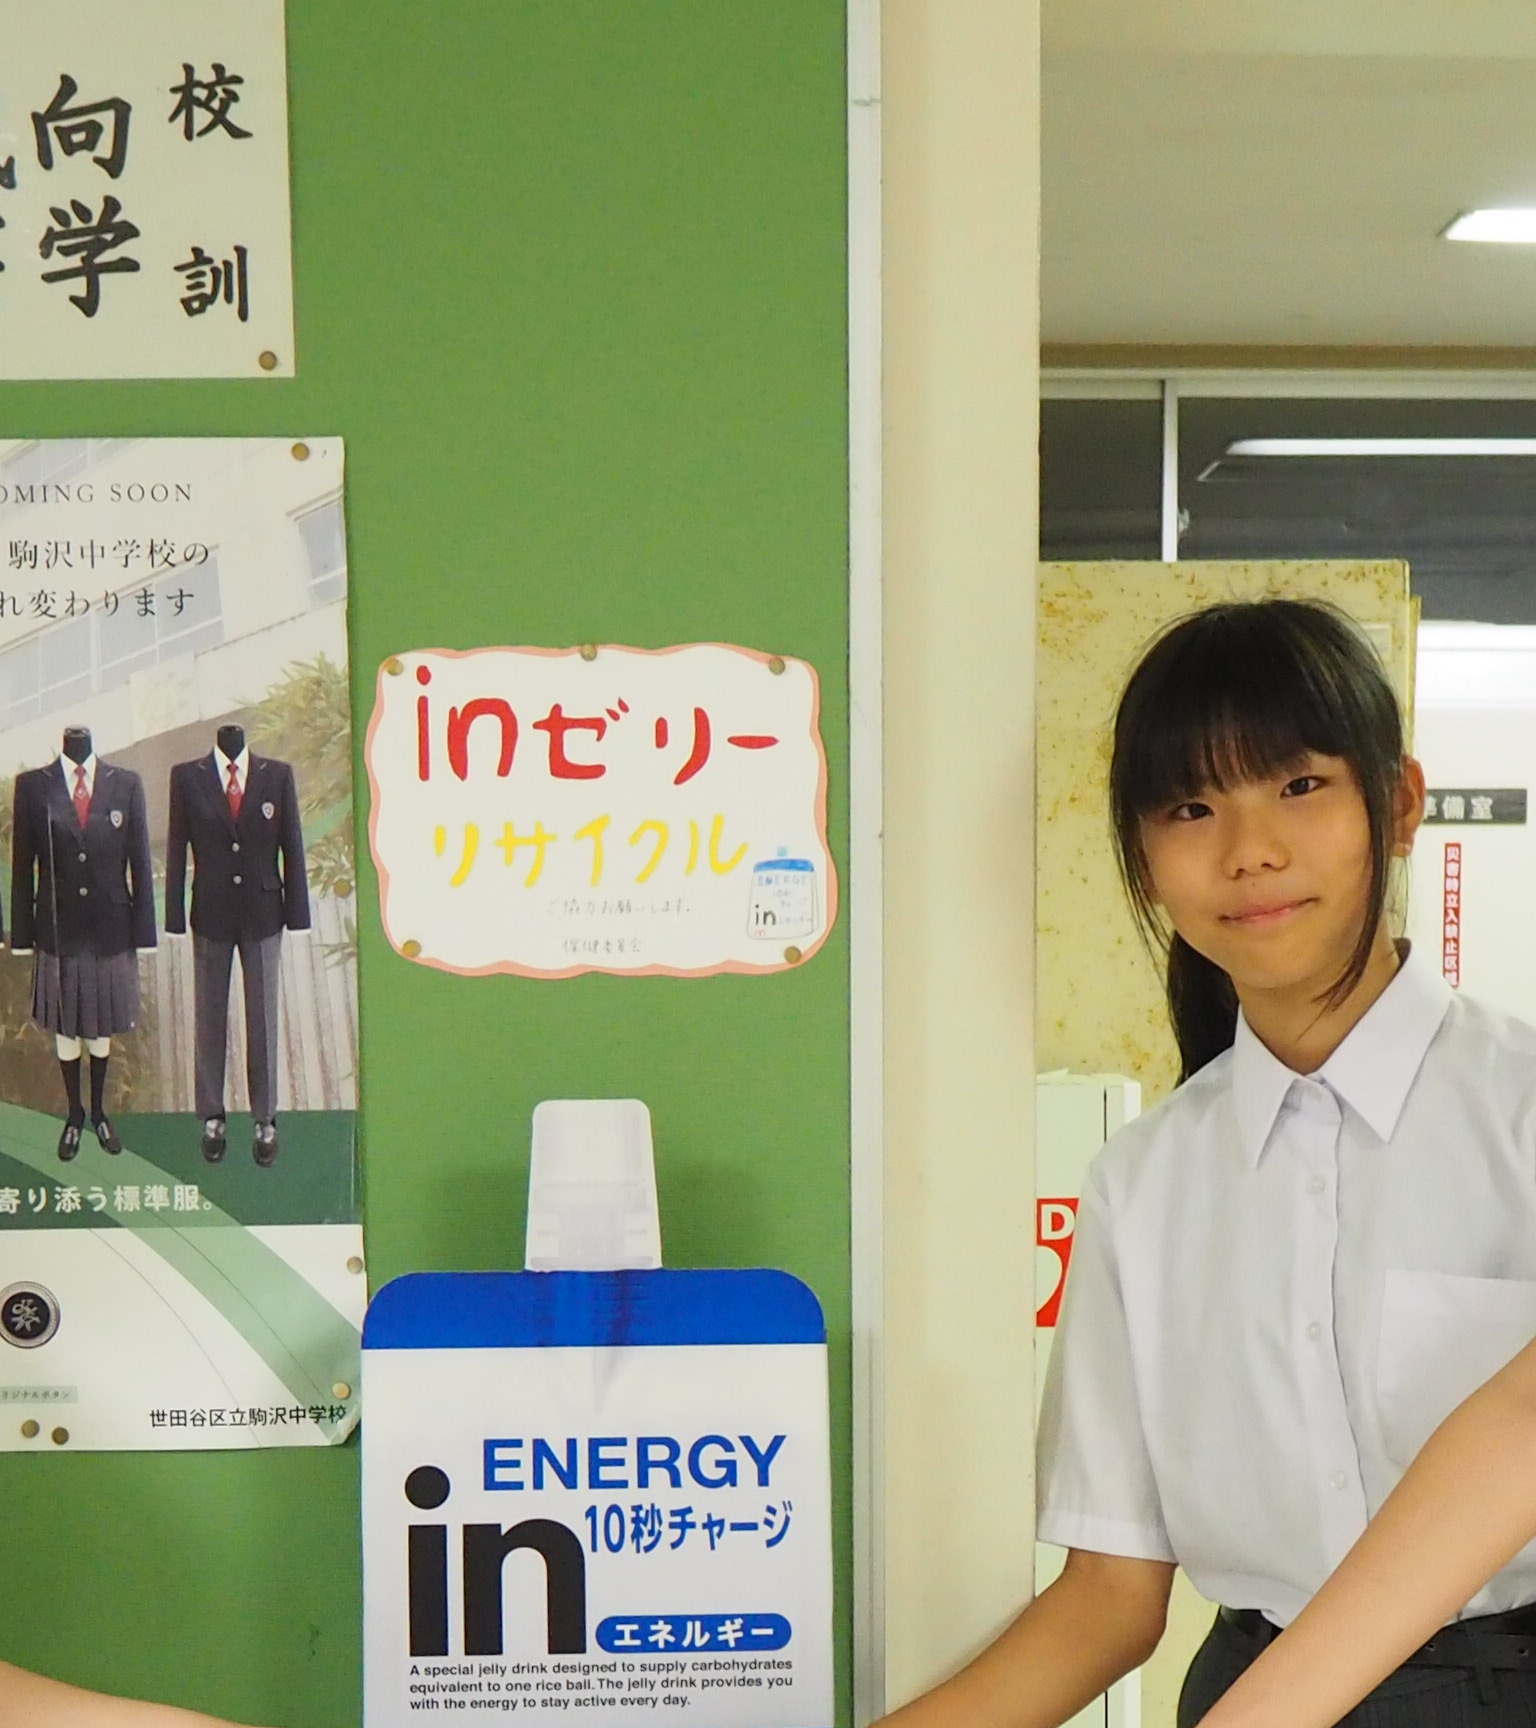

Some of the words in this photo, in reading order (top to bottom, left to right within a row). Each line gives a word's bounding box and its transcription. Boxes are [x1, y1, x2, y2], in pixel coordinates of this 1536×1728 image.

[110, 481, 193, 503] SOON
[415, 664, 780, 786] inゼリー
[433, 813, 750, 888] リサイクル
[755, 903, 777, 926] in
[148, 1403, 348, 1430] 世田谷区立駒沢中学校
[482, 1433, 788, 1492] ENERGY
[584, 1500, 794, 1555] 10秒チャージ
[403, 1464, 588, 1658] in
[613, 1618, 776, 1649] エネルギー
[410, 1664, 420, 1676] A
[424, 1663, 474, 1679] special
[478, 1663, 507, 1678] jelly
[512, 1662, 548, 1674] drink
[552, 1661, 618, 1676] designed
[622, 1661, 635, 1673] to
[640, 1660, 687, 1676] supply
[691, 1658, 793, 1674] carbohydrates
[410, 1680, 484, 1697] equivalent
[487, 1680, 501, 1692] to
[505, 1682, 532, 1693] one
[536, 1679, 562, 1691] rice
[566, 1678, 594, 1691] ball.
[598, 1677, 624, 1690] The
[627, 1677, 656, 1693] jelly
[661, 1676, 697, 1689] drink
[701, 1675, 763, 1691] provides
[767, 1677, 793, 1691] you
[410, 1697, 440, 1710] with
[443, 1697, 466, 1709] the
[470, 1698, 518, 1711] energy
[522, 1696, 537, 1708] to
[541, 1696, 571, 1710] stay
[574, 1695, 616, 1707] active
[620, 1695, 659, 1709] every
[662, 1694, 692, 1708] day.
